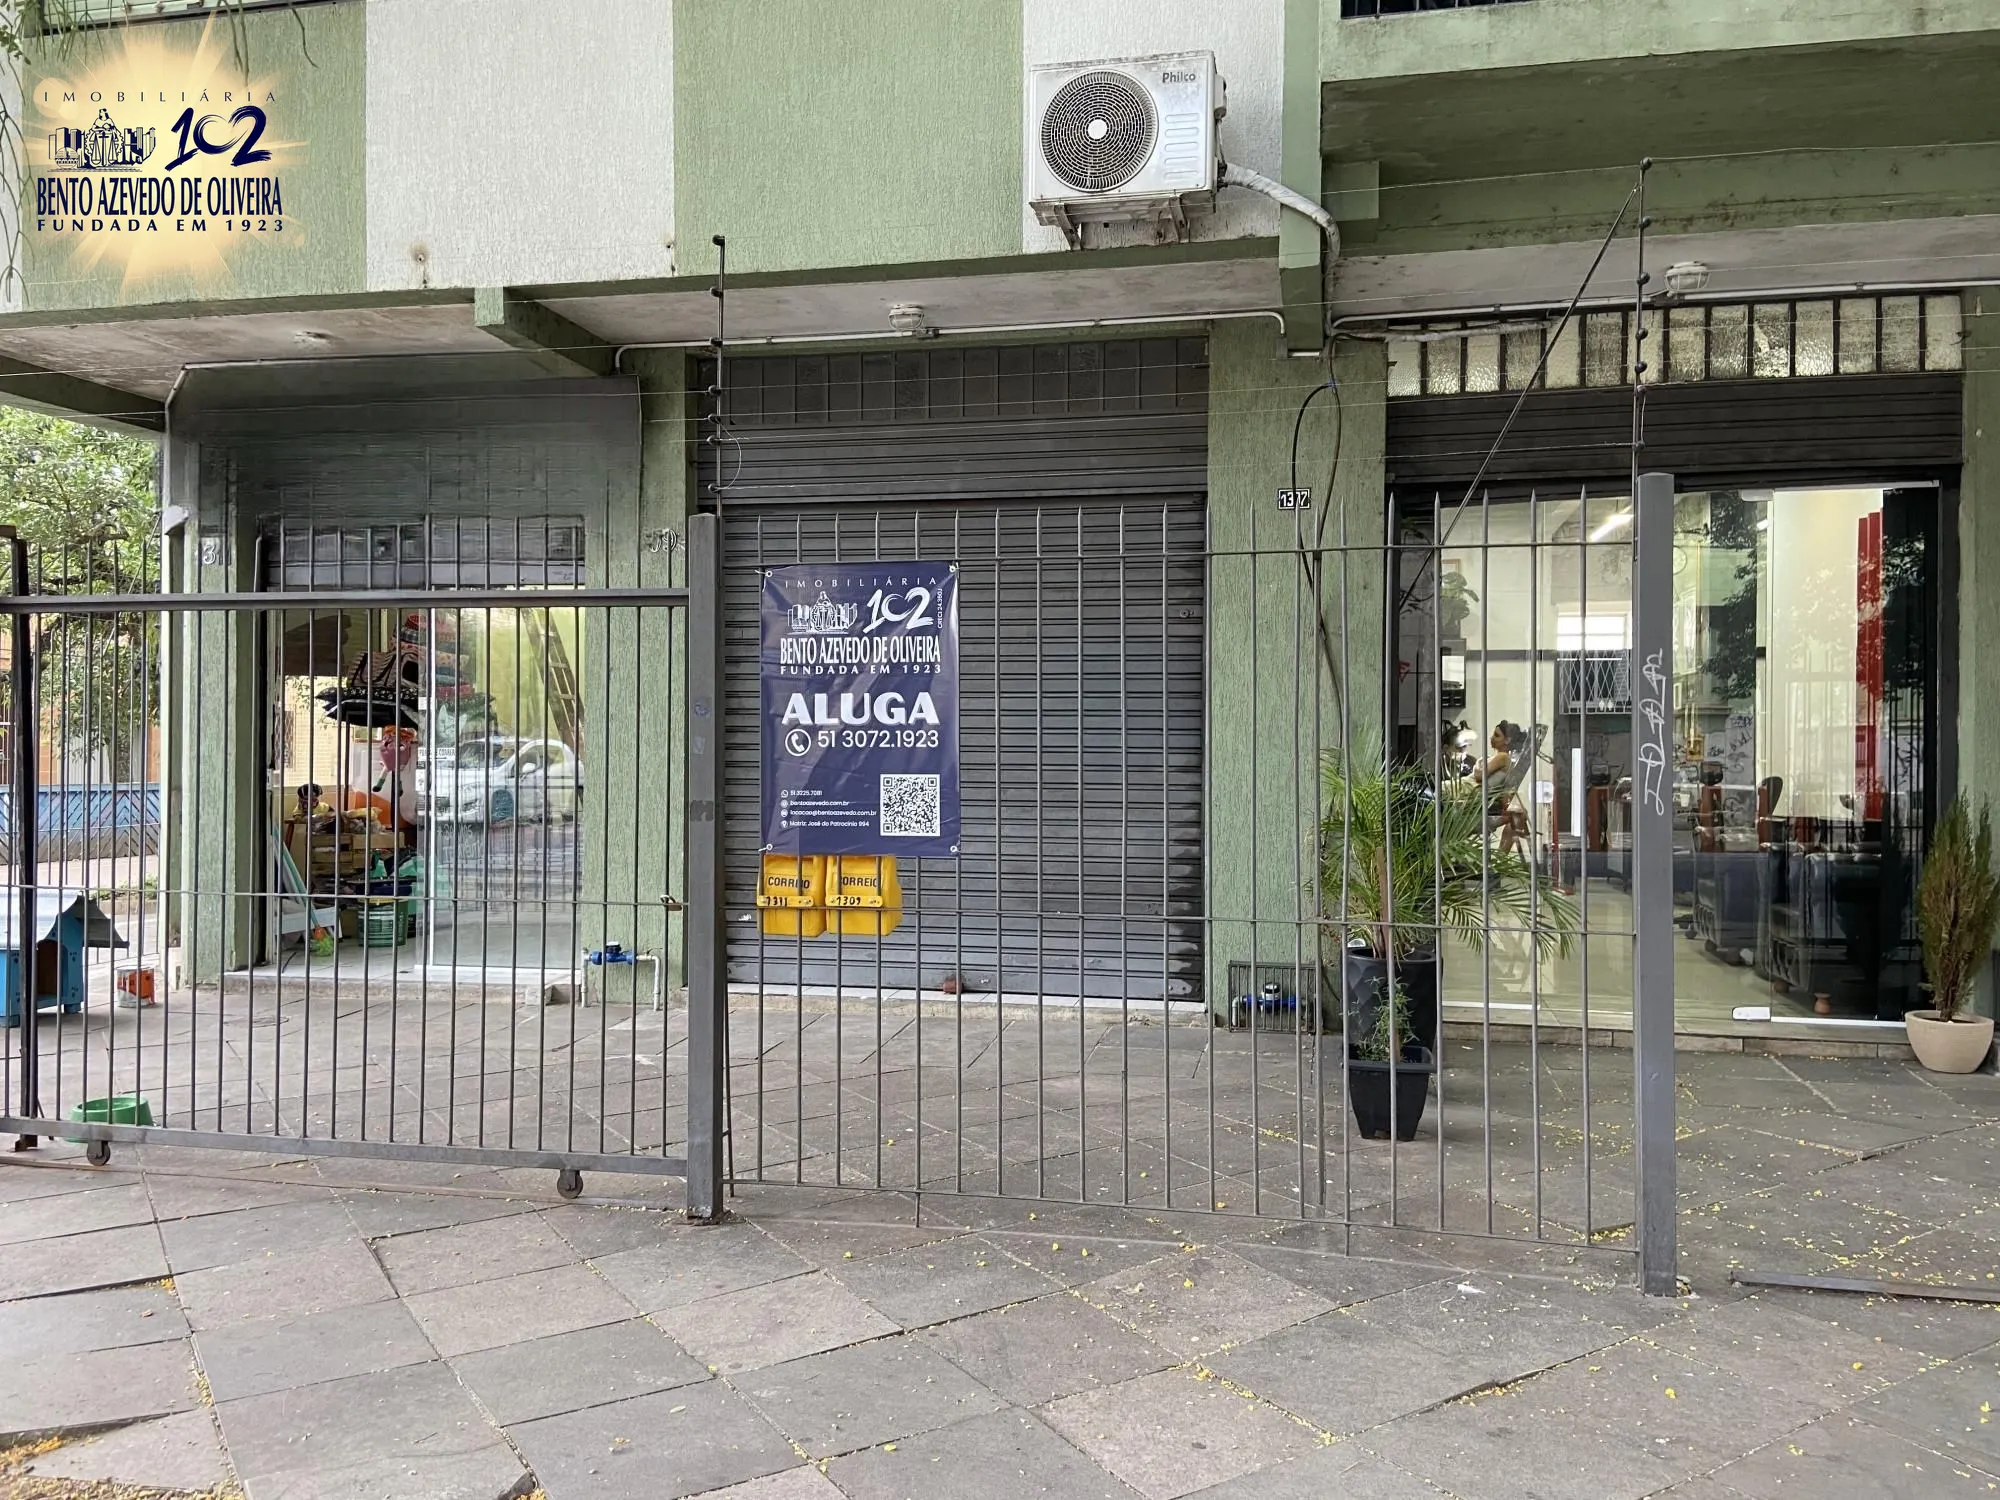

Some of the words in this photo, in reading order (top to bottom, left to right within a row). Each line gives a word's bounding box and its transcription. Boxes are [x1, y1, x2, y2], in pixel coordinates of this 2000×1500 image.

[1162, 71, 1197, 84] Philco
[785, 575, 937, 589] IMOBILIÁRIA
[862, 587, 935, 633] 102
[780, 637, 817, 665] BENTO
[819, 636, 871, 664] AZEVEDO
[873, 636, 889, 663] DE
[890, 635, 941, 663] OLIVEIRA
[780, 665, 859, 675] FUNDADA
[870, 665, 890, 675] EM
[902, 664, 942, 675] 1923
[781, 692, 941, 726] ALUGA
[818, 730, 836, 748] 51
[842, 730, 939, 748] 3072.1923
[836, 896, 861, 906] 1309
